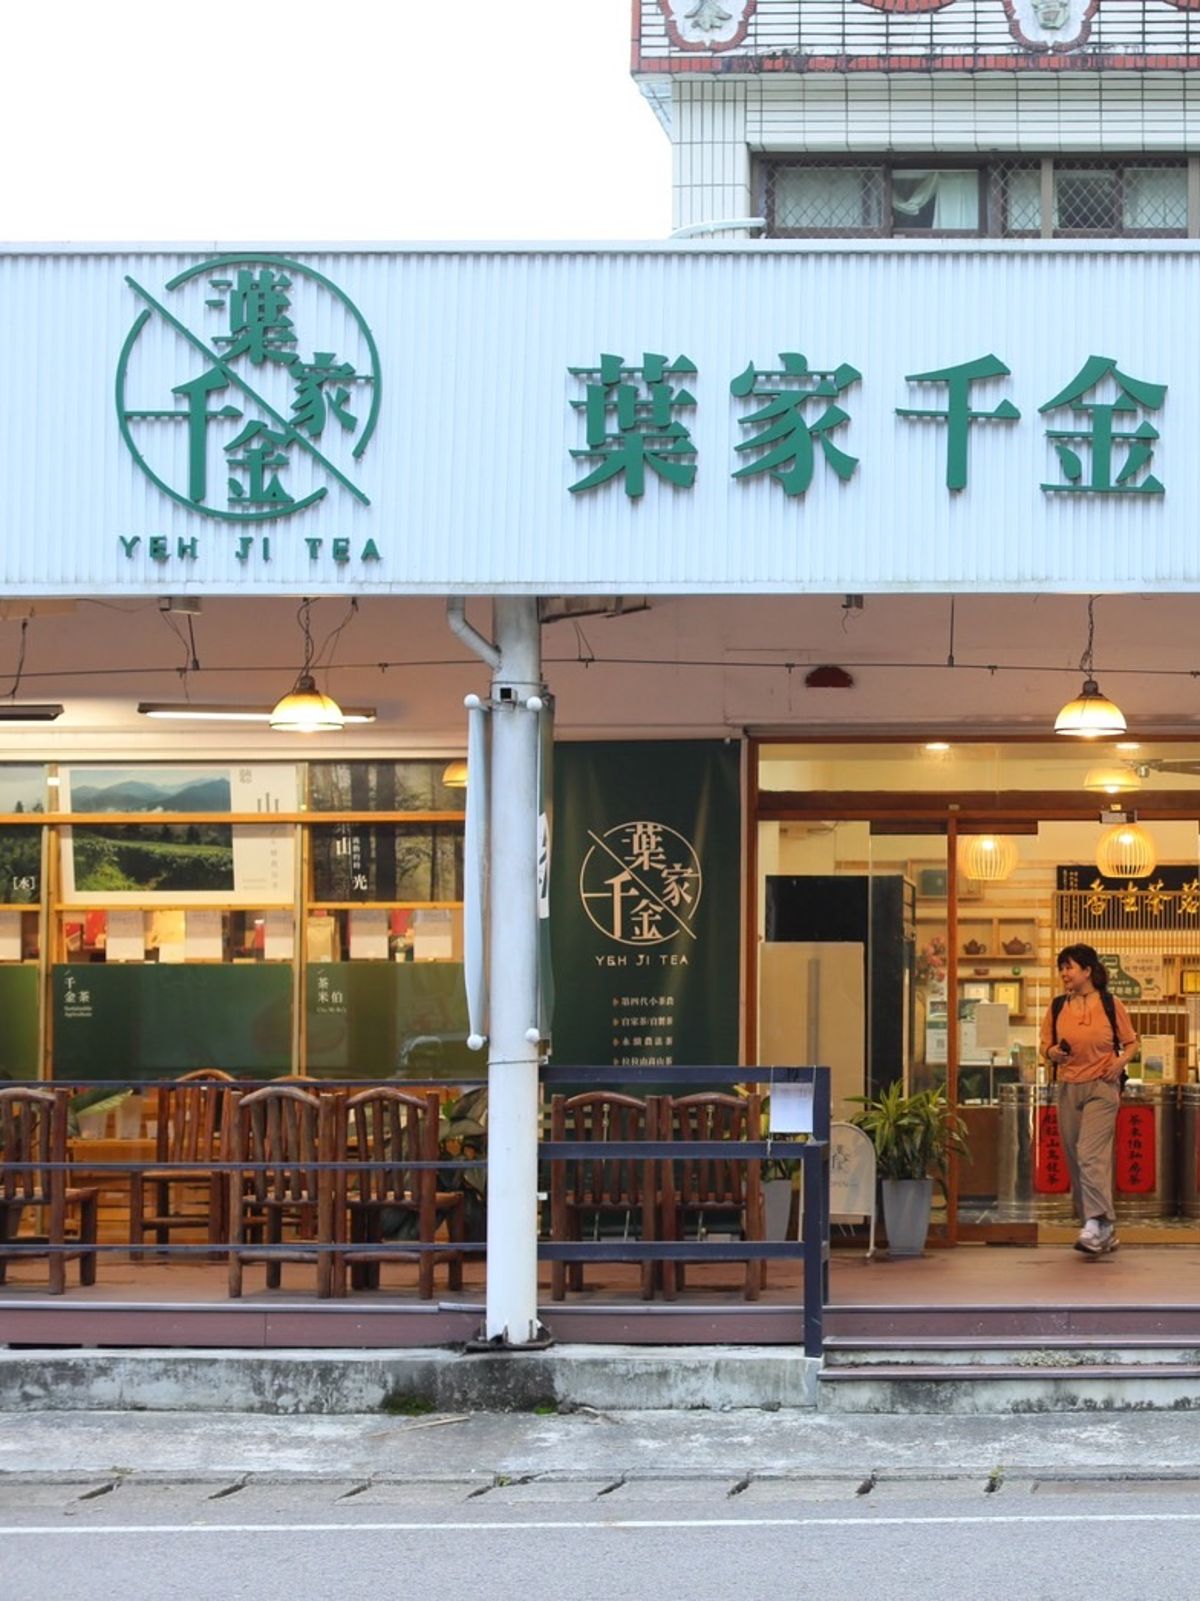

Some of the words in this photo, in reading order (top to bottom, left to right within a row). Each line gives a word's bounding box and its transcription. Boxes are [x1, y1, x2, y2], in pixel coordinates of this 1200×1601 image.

[567, 352, 1169, 498] 葉家千金
[119, 535, 199, 561] YEH
[234, 535, 271, 561] JI
[304, 536, 381, 561] TEA
[595, 954, 627, 967] YEH
[636, 954, 650, 966] JI
[660, 954, 689, 966] TEA
